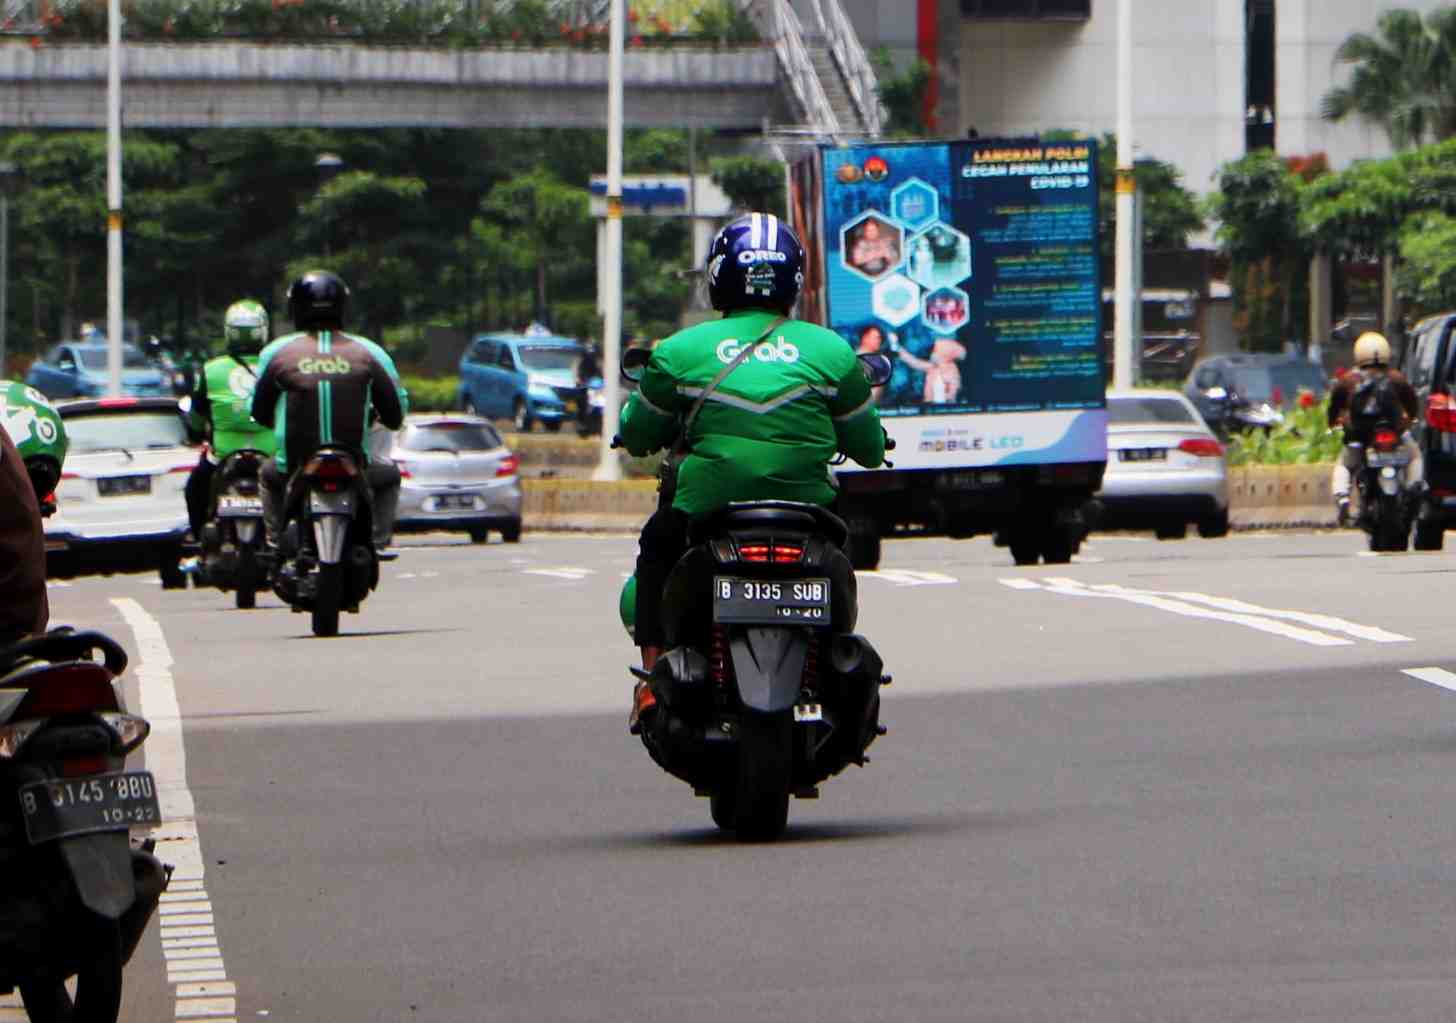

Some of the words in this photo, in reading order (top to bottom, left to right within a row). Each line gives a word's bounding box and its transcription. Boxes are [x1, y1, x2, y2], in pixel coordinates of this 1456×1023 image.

[738, 250, 786, 264] OREO
[297, 355, 351, 374] Grab
[722, 581, 731, 599] B
[743, 583, 781, 600] 3135
[793, 583, 822, 601] SUB
